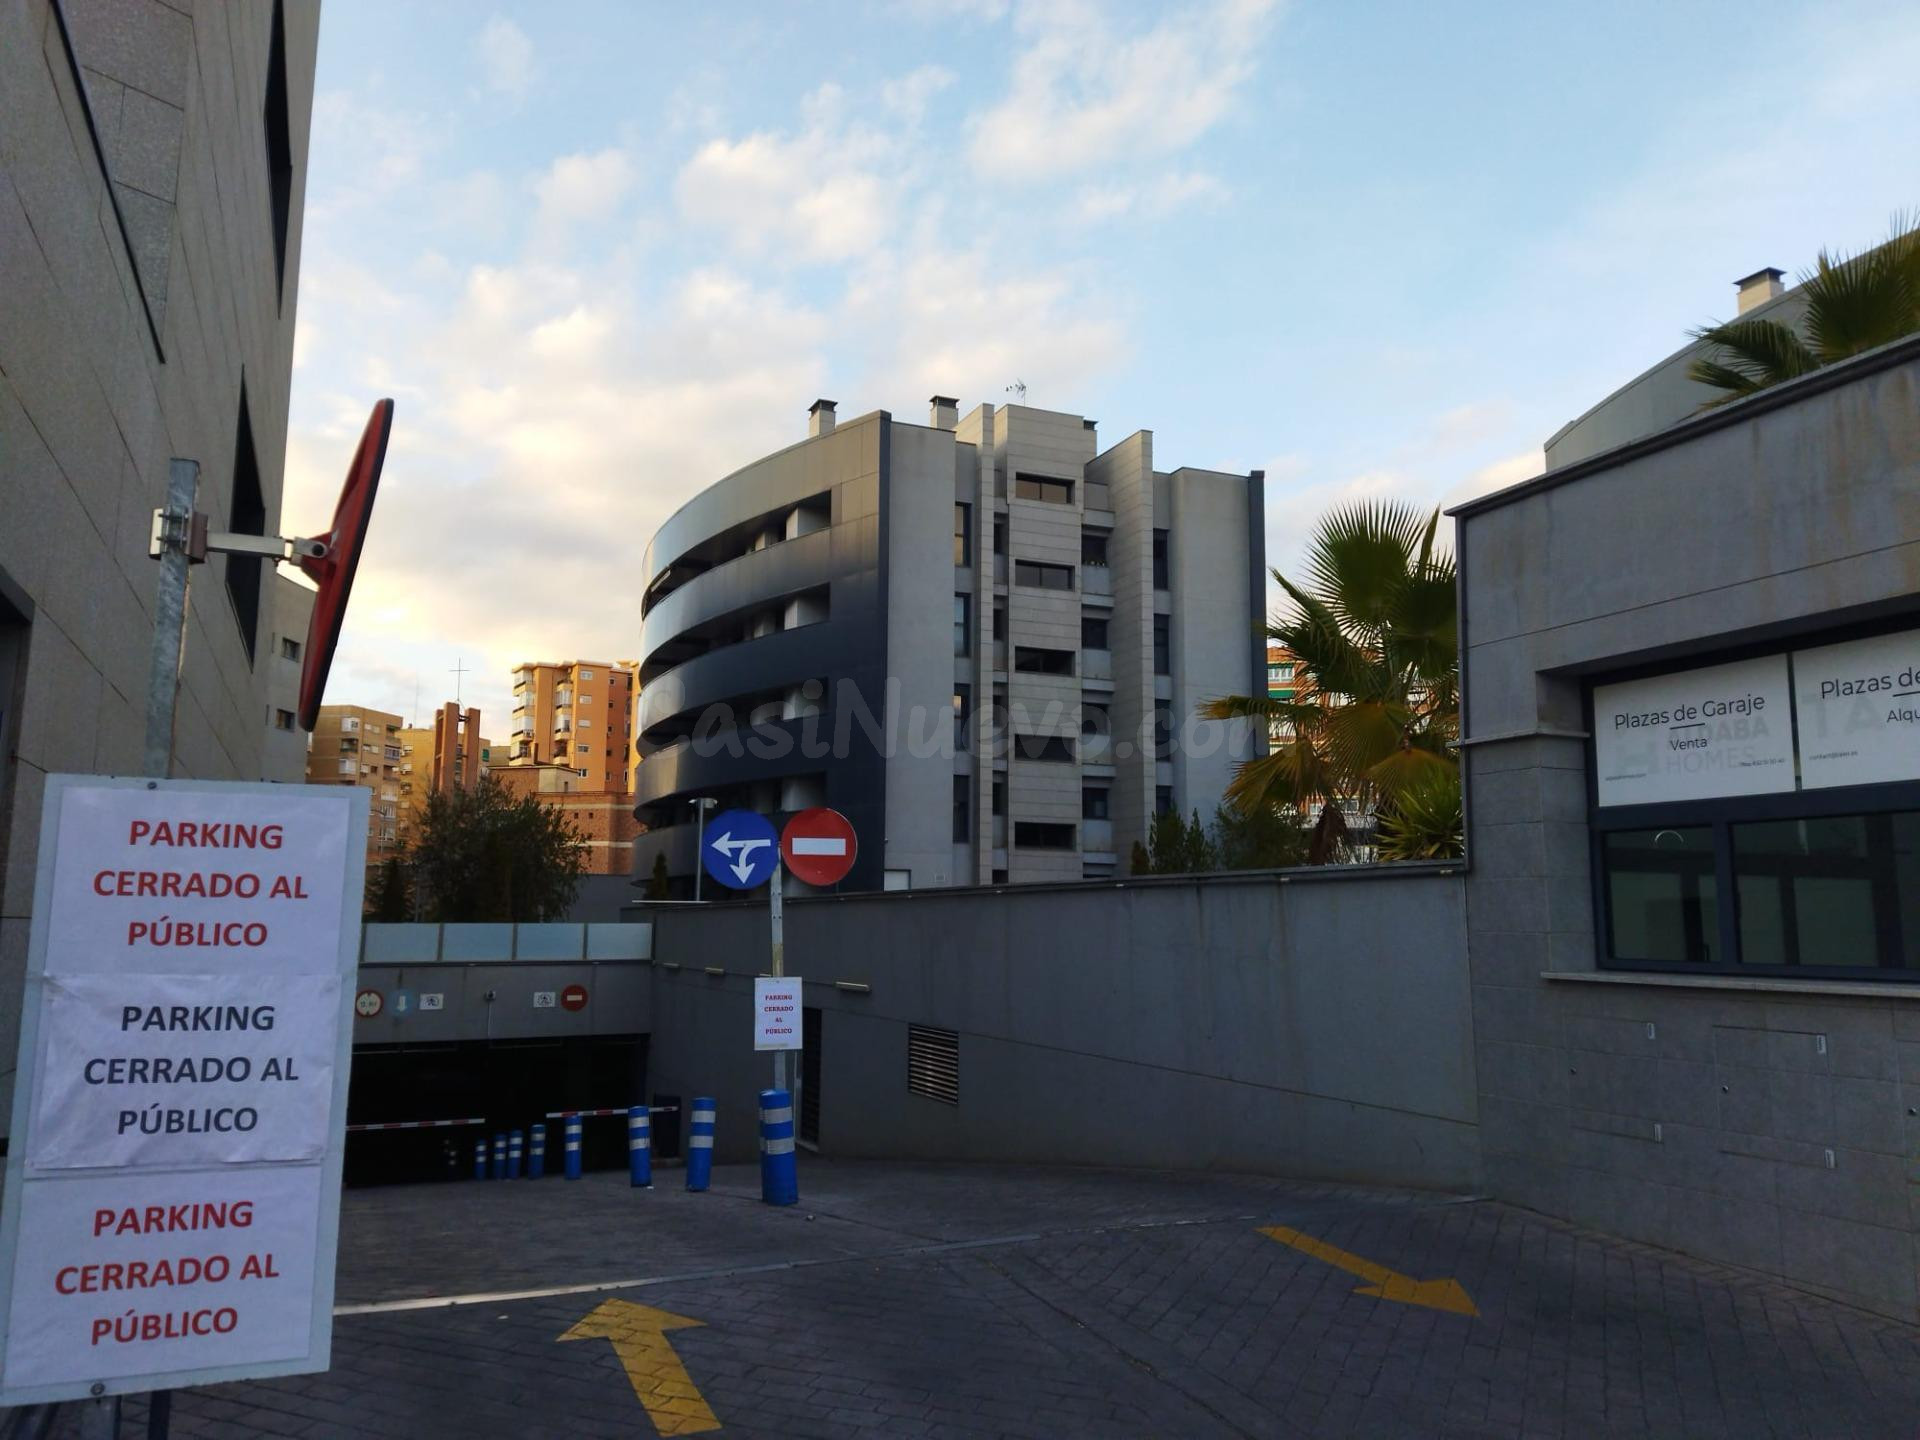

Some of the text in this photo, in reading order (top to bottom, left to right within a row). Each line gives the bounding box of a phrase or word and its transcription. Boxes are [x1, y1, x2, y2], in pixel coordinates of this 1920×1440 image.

[1820, 675, 1892, 699] Plazas
[1615, 694, 1765, 730] Plazas de Garaje
[1669, 737, 1708, 751] Venta
[129, 820, 283, 850] PARKING
[93, 870, 309, 899] CERRADO AL
[128, 915, 268, 947] PÚBLICO
[121, 1005, 275, 1032] PARKING
[84, 1056, 299, 1085] CERRADO AL
[117, 1102, 258, 1135] PÚBLICO
[93, 1201, 253, 1237] PARKING
[55, 1253, 280, 1295] CERRADO AL
[91, 1307, 238, 1346] PÚBLICO
